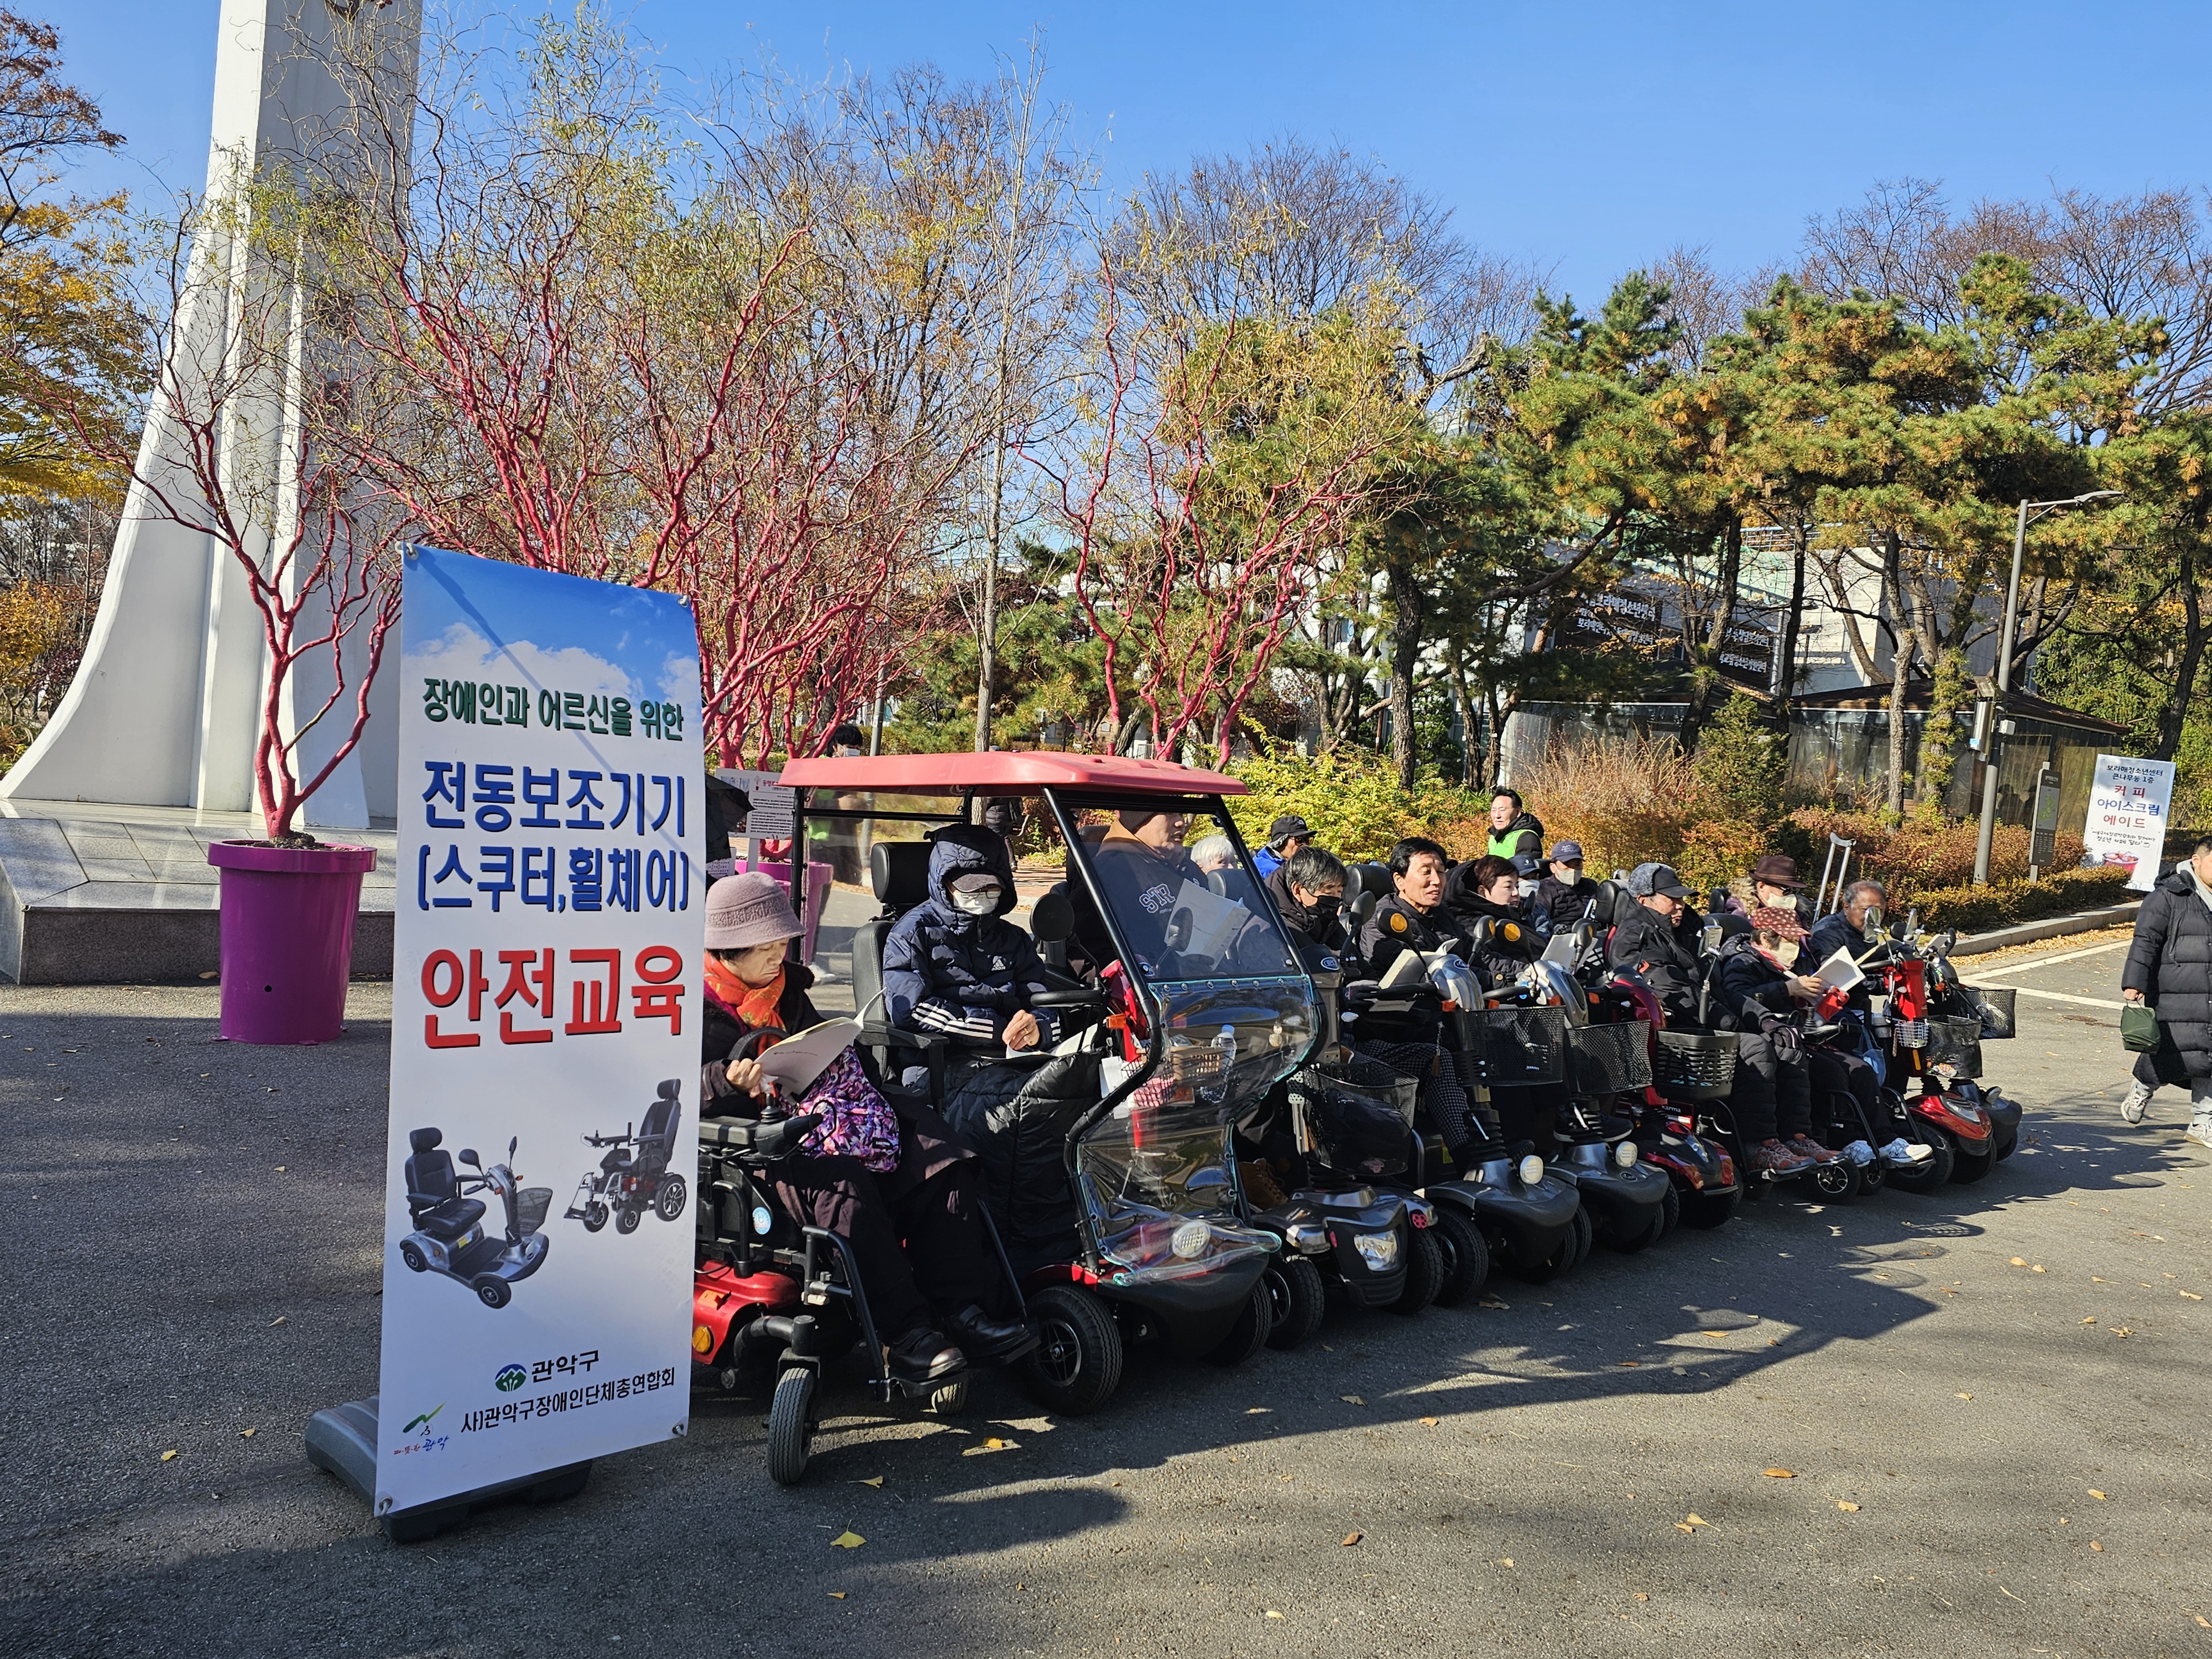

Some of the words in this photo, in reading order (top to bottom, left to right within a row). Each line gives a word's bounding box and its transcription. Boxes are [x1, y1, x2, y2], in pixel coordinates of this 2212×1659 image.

[422, 678, 529, 727] 장애인과
[538, 689, 632, 736] 어르신을
[639, 700, 684, 741] 위한
[2106, 765, 2163, 776] 보라매청소년센터
[2112, 773, 2140, 782] 큰나무동
[421, 760, 685, 837] 전동보조기기
[2098, 799, 2159, 816] 아이스크림
[2104, 815, 2145, 828] 에이드
[421, 945, 685, 1049] 안전교육
[532, 1350, 599, 1383] 관악구
[422, 1436, 449, 1451] 관악
